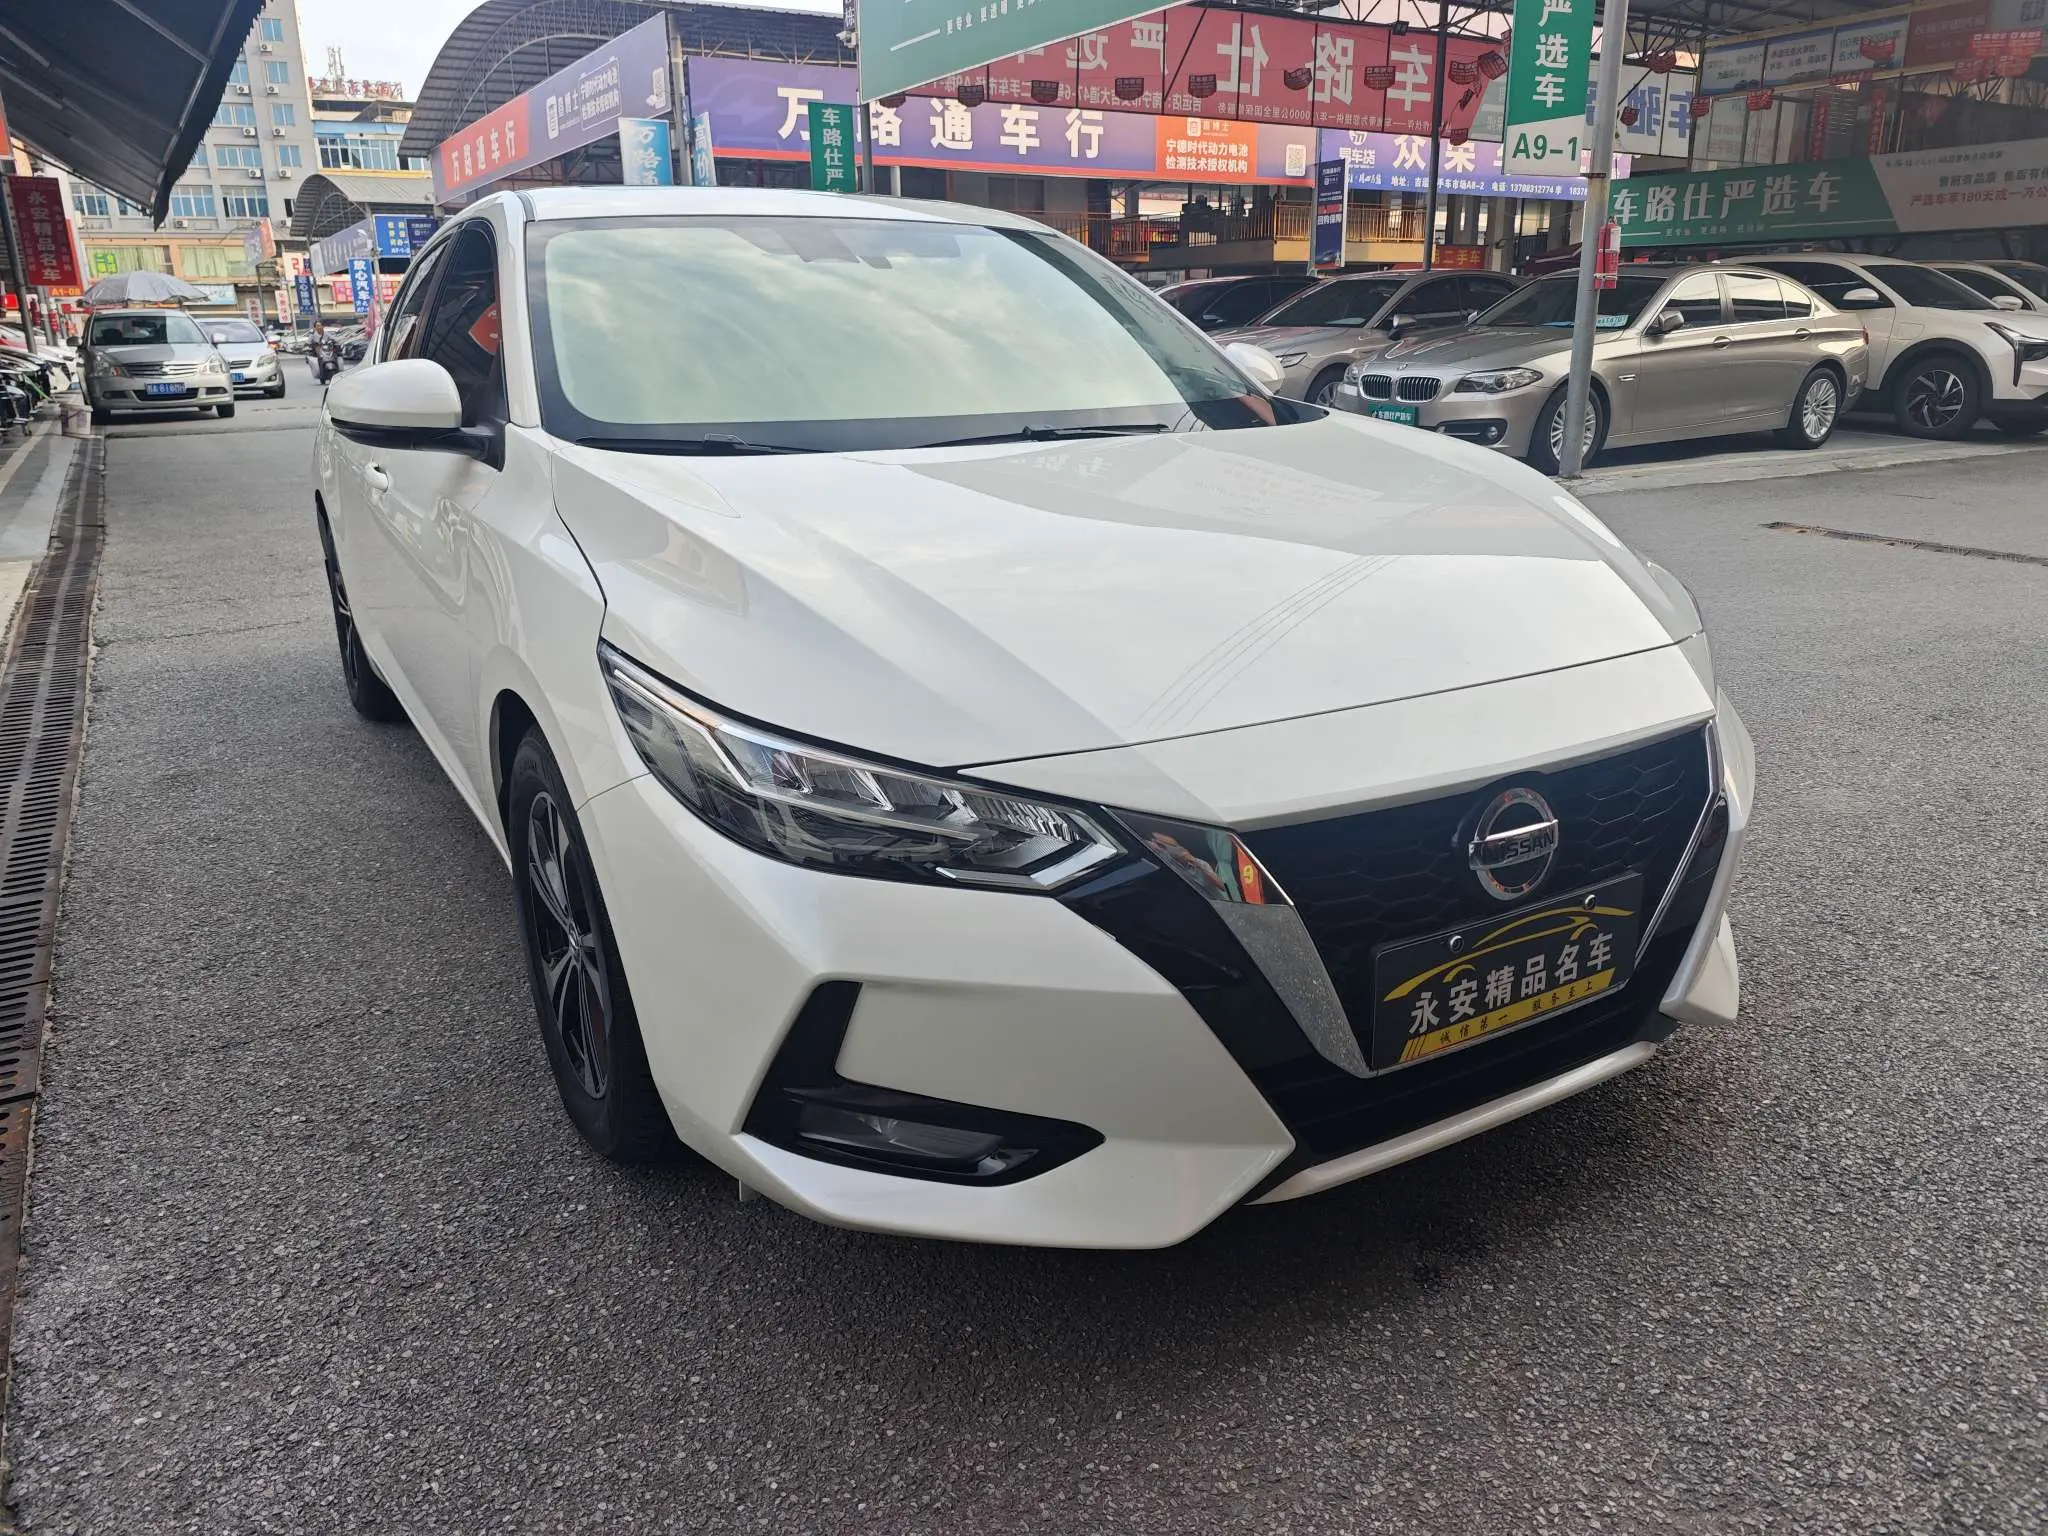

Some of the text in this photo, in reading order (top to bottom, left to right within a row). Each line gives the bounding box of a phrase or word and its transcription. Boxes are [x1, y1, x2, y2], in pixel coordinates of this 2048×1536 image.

[1533, 0, 1573, 108] 严选车
[451, 119, 516, 183] 万路通车行
[821, 107, 845, 192] 车路仕严
[1165, 155, 1248, 173] 检测技术授权机构
[1166, 139, 1249, 157] 宁德时代动力电池
[1511, 132, 1578, 161] A9-1
[1612, 170, 1842, 226] 车路仕严选车
[1408, 932, 1614, 1035] 永安精品名车
